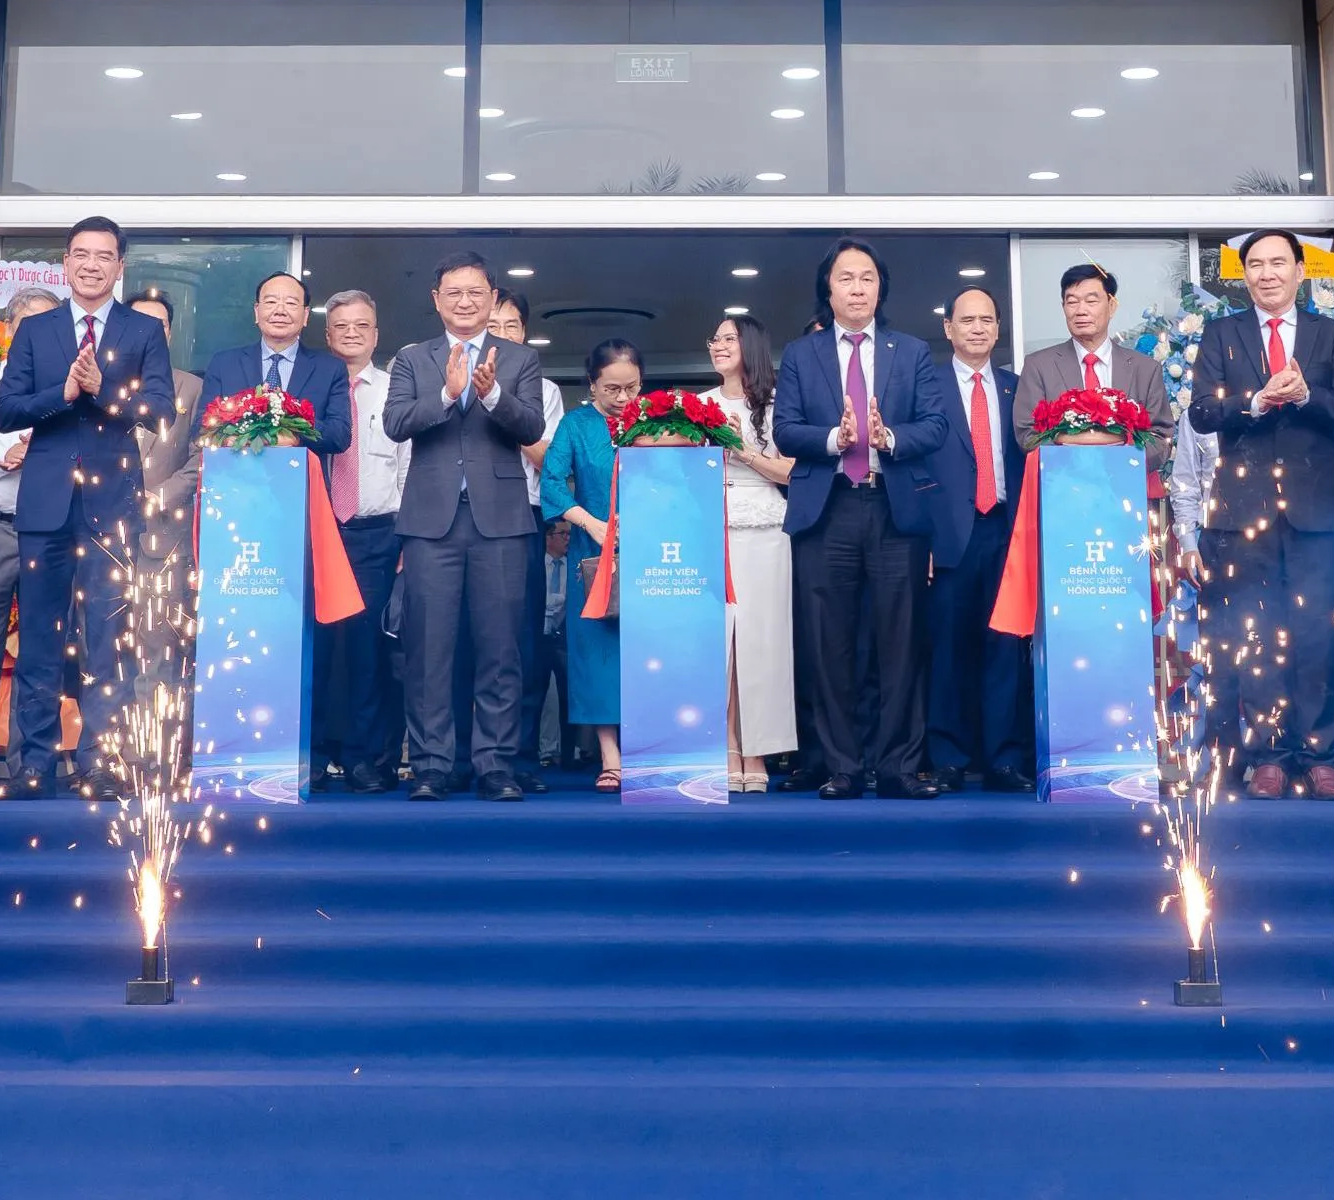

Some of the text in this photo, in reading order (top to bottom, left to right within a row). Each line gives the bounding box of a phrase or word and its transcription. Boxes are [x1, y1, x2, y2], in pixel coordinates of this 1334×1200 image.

[631, 58, 675, 68] EXIT
[11, 268, 16, 281] Y
[19, 268, 41, 286] Dược
[241, 542, 261, 563] H
[661, 542, 682, 563] H
[1085, 541, 1107, 562] H
